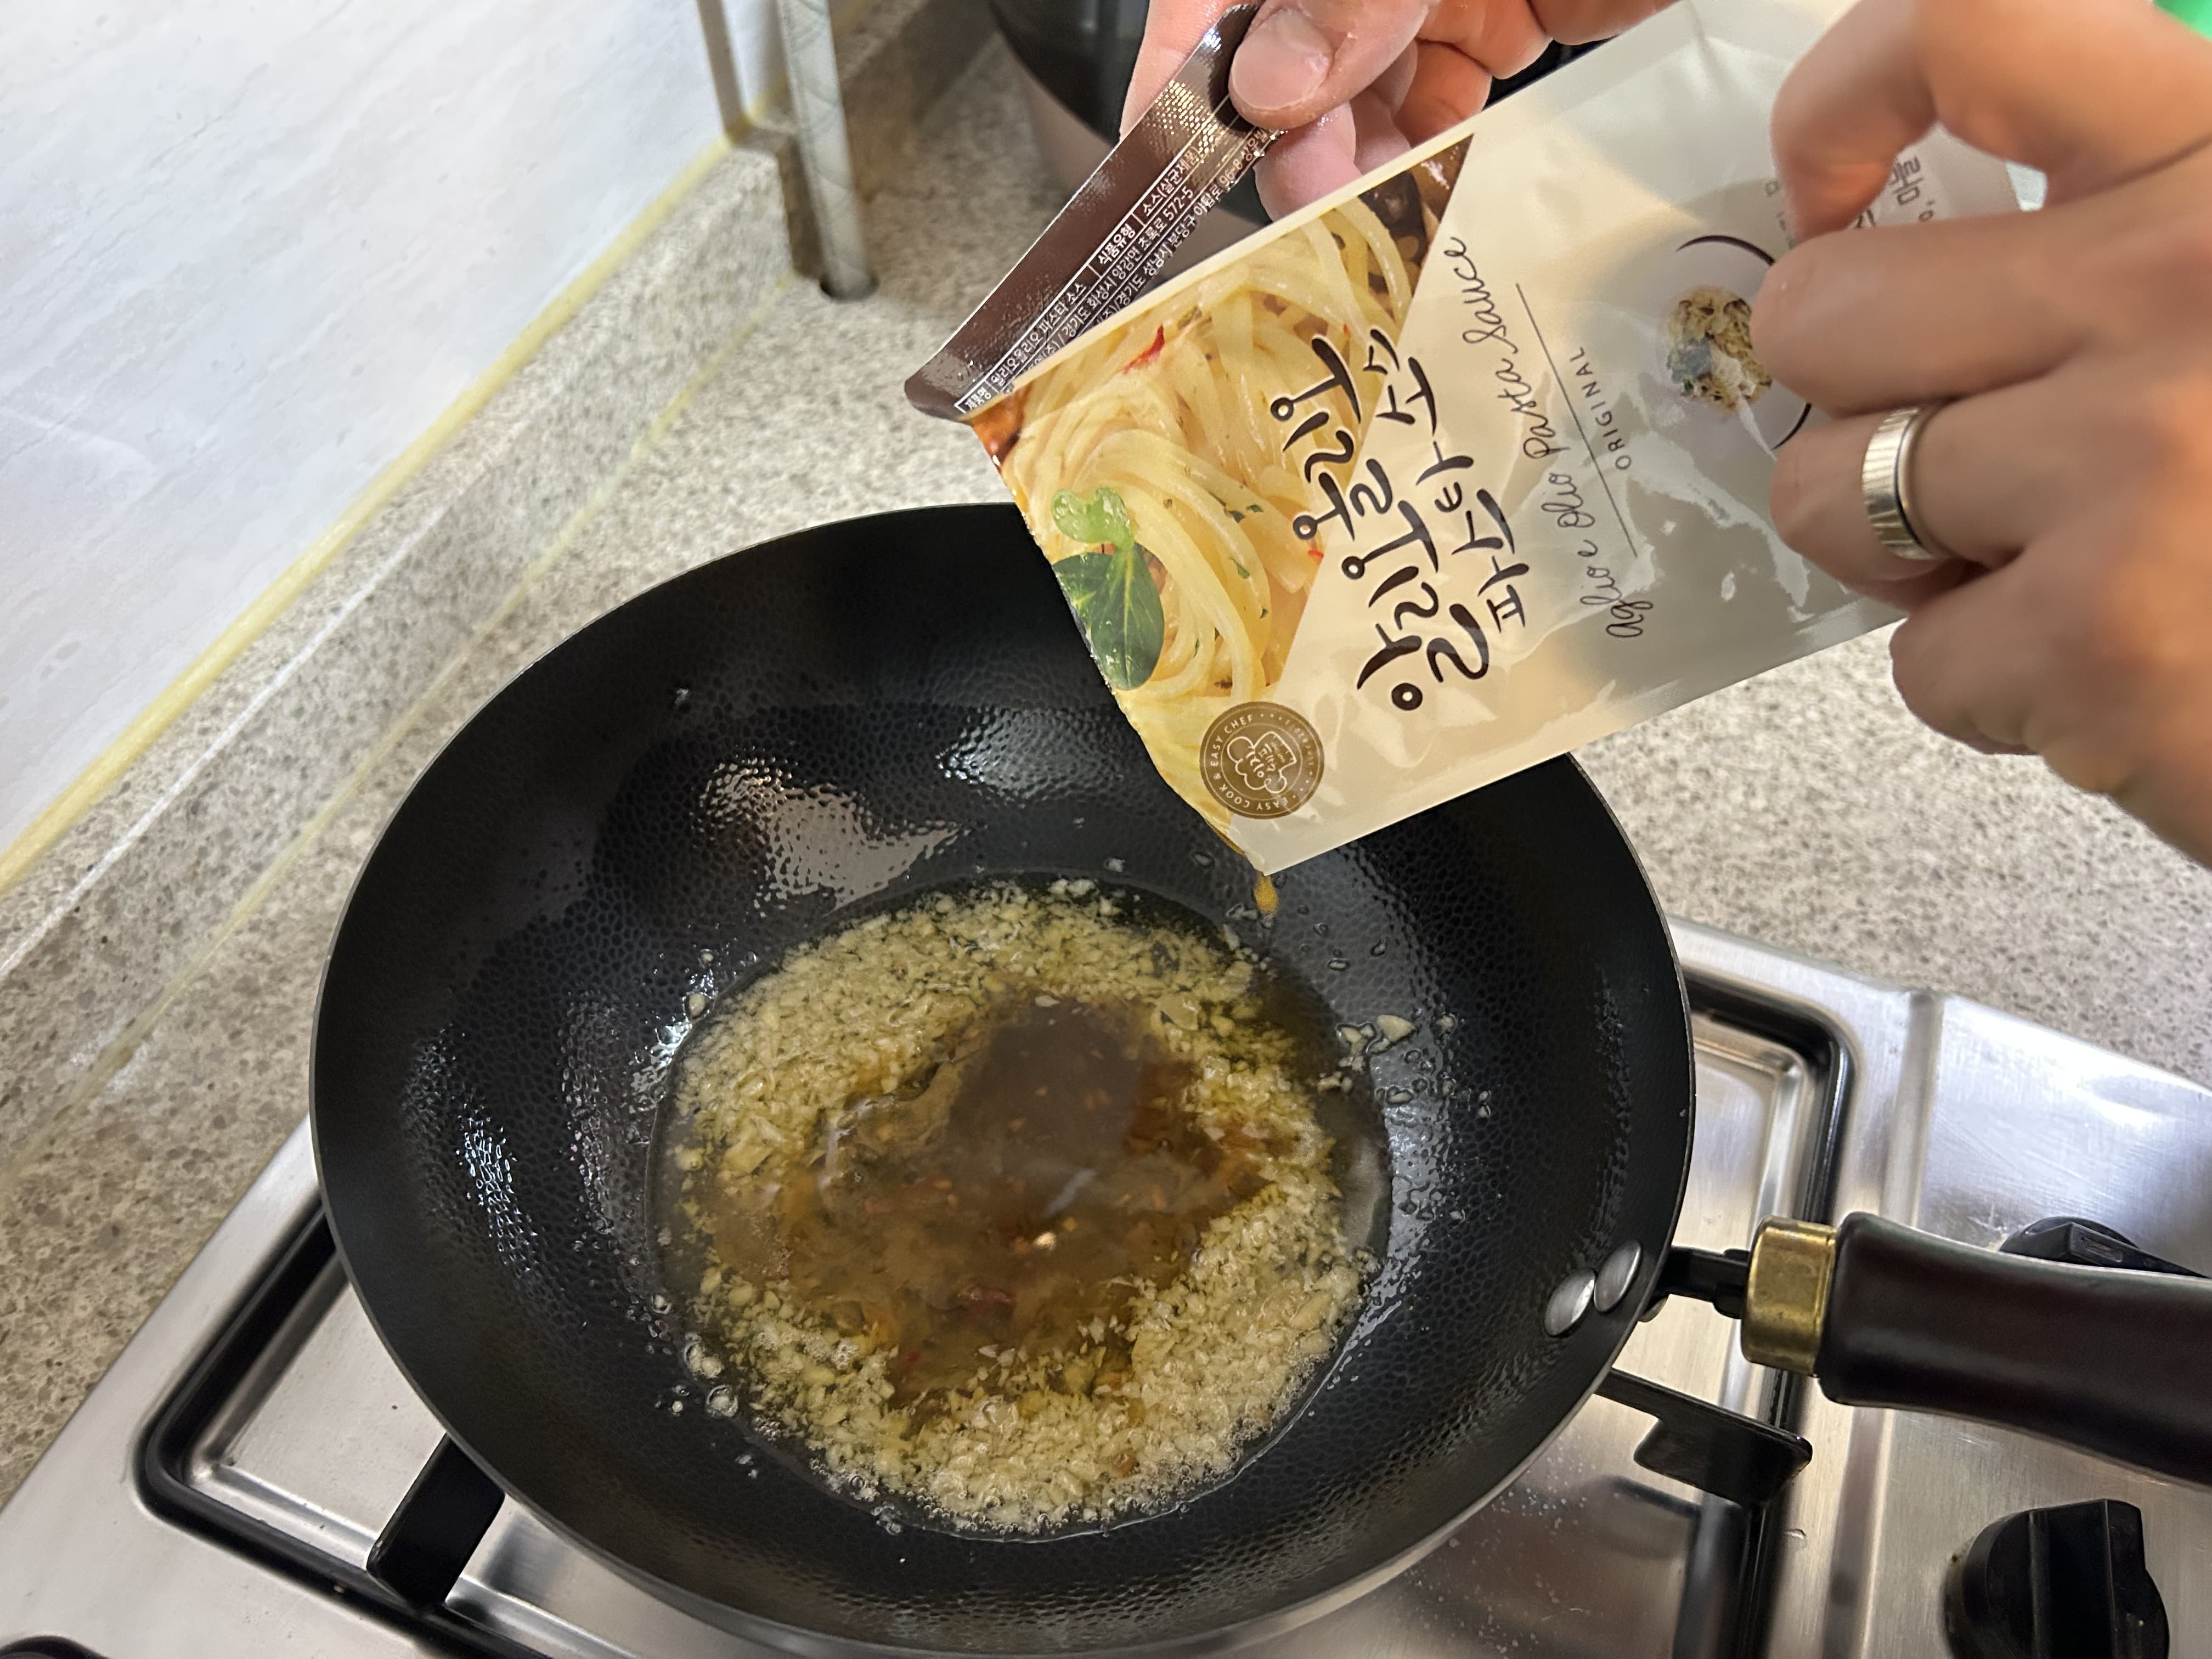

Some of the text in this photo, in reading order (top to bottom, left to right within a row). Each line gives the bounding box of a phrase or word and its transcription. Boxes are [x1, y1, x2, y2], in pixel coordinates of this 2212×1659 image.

[1094, 144, 1203, 268] 식품유형 소스(살균제품)
[1140, 243, 1174, 279] 성남시
[1166, 212, 1199, 248] 분당구
[1217, 157, 1245, 187] 96-8
[1037, 300, 1070, 335] 파스타
[1064, 280, 1088, 305] 소스
[1060, 305, 1093, 339] 경기도
[1085, 276, 1119, 312] 화성시
[1110, 246, 1145, 282] 양감면
[1136, 217, 1169, 252] 초록로
[1161, 185, 1195, 222] 572-5
[1443, 236, 1519, 354] Sauce
[1494, 358, 1570, 459] Pasta
[1570, 347, 1632, 471] ORIGINAL
[1269, 336, 1489, 711] 알리오올리오
[1360, 329, 1530, 634] 파스타 소스
[1541, 472, 1595, 528] Olio
[1210, 736, 1223, 766] EASY
[1224, 714, 1253, 733] CHEF
[1219, 784, 1251, 808] COOK
[1256, 797, 1288, 811] EASY
